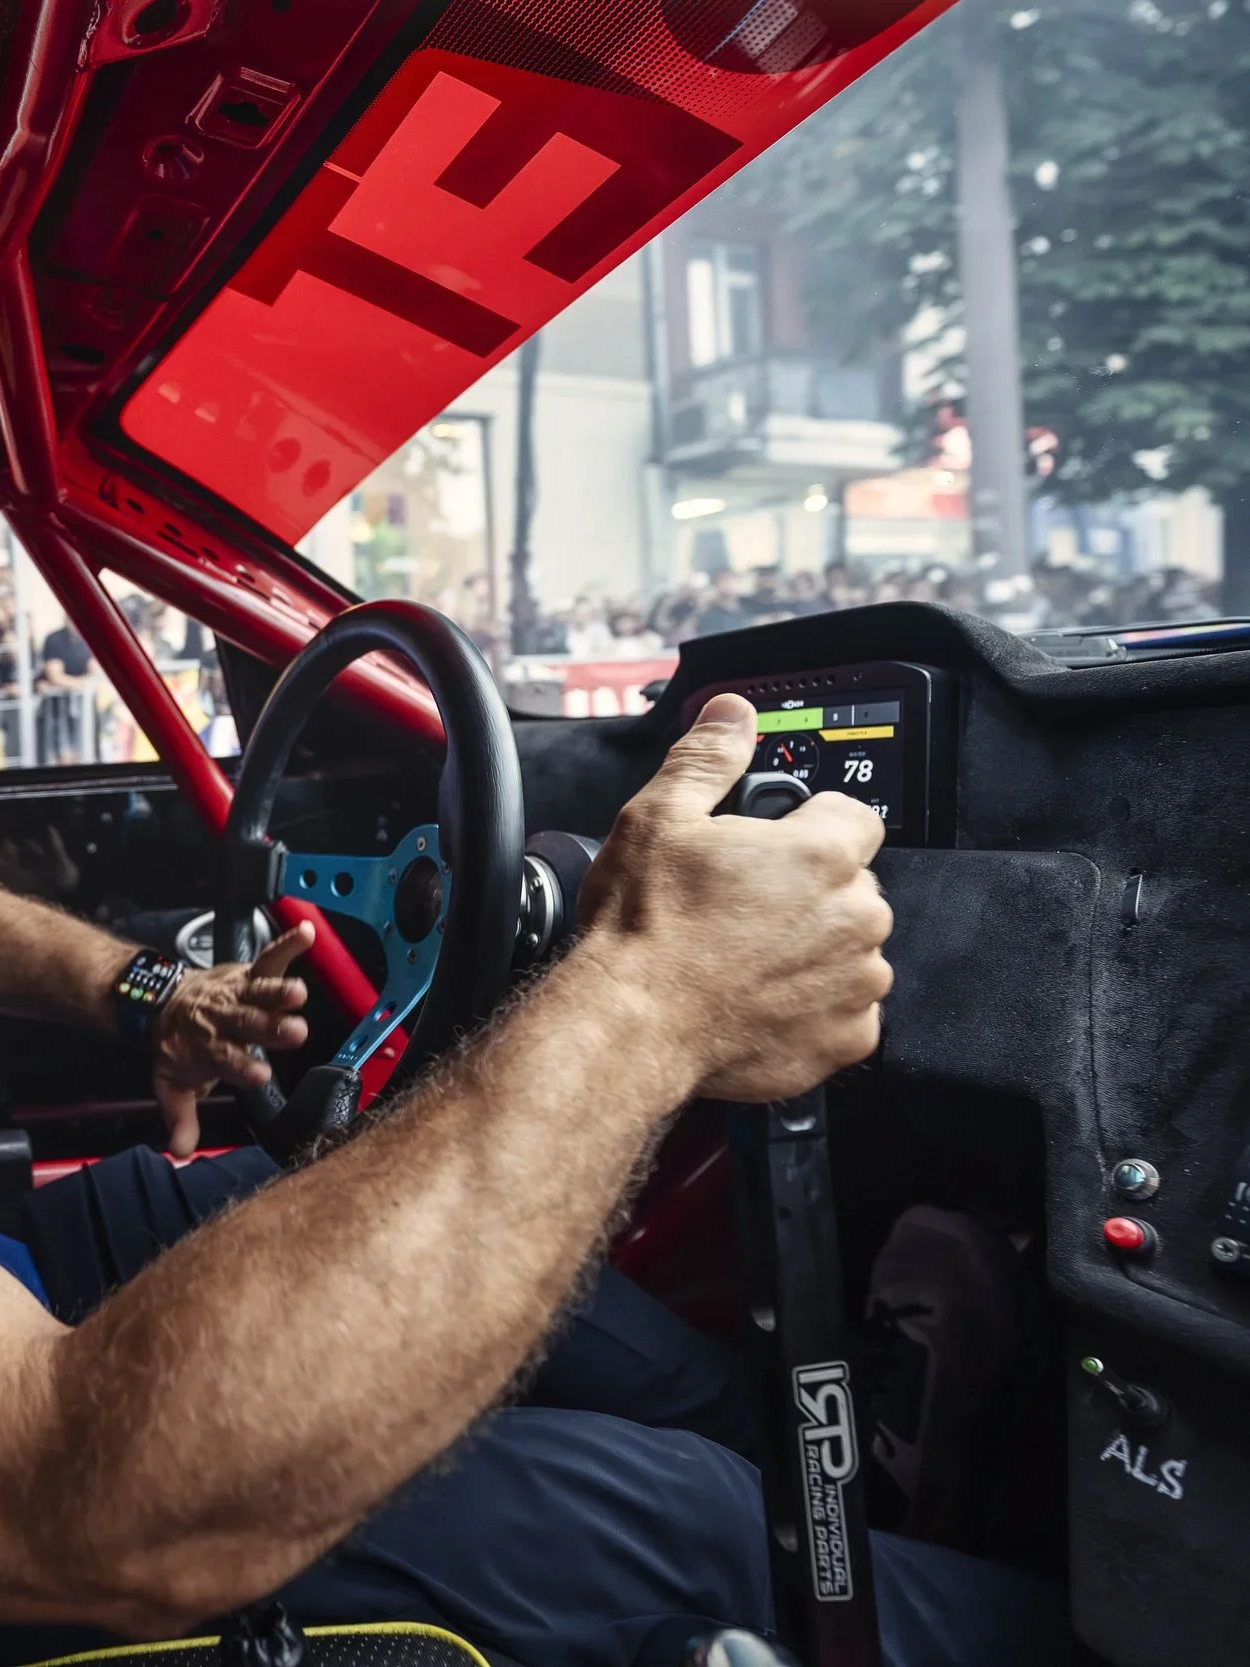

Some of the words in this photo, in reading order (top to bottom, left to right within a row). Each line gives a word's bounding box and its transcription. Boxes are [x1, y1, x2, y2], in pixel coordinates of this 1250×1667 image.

[843, 759, 874, 783] 78
[805, 1444, 826, 1520] RACING
[1100, 1433, 1188, 1500] ALS
[814, 1525, 834, 1594] PARTS
[824, 1484, 847, 1594] INDIVIDUAL
